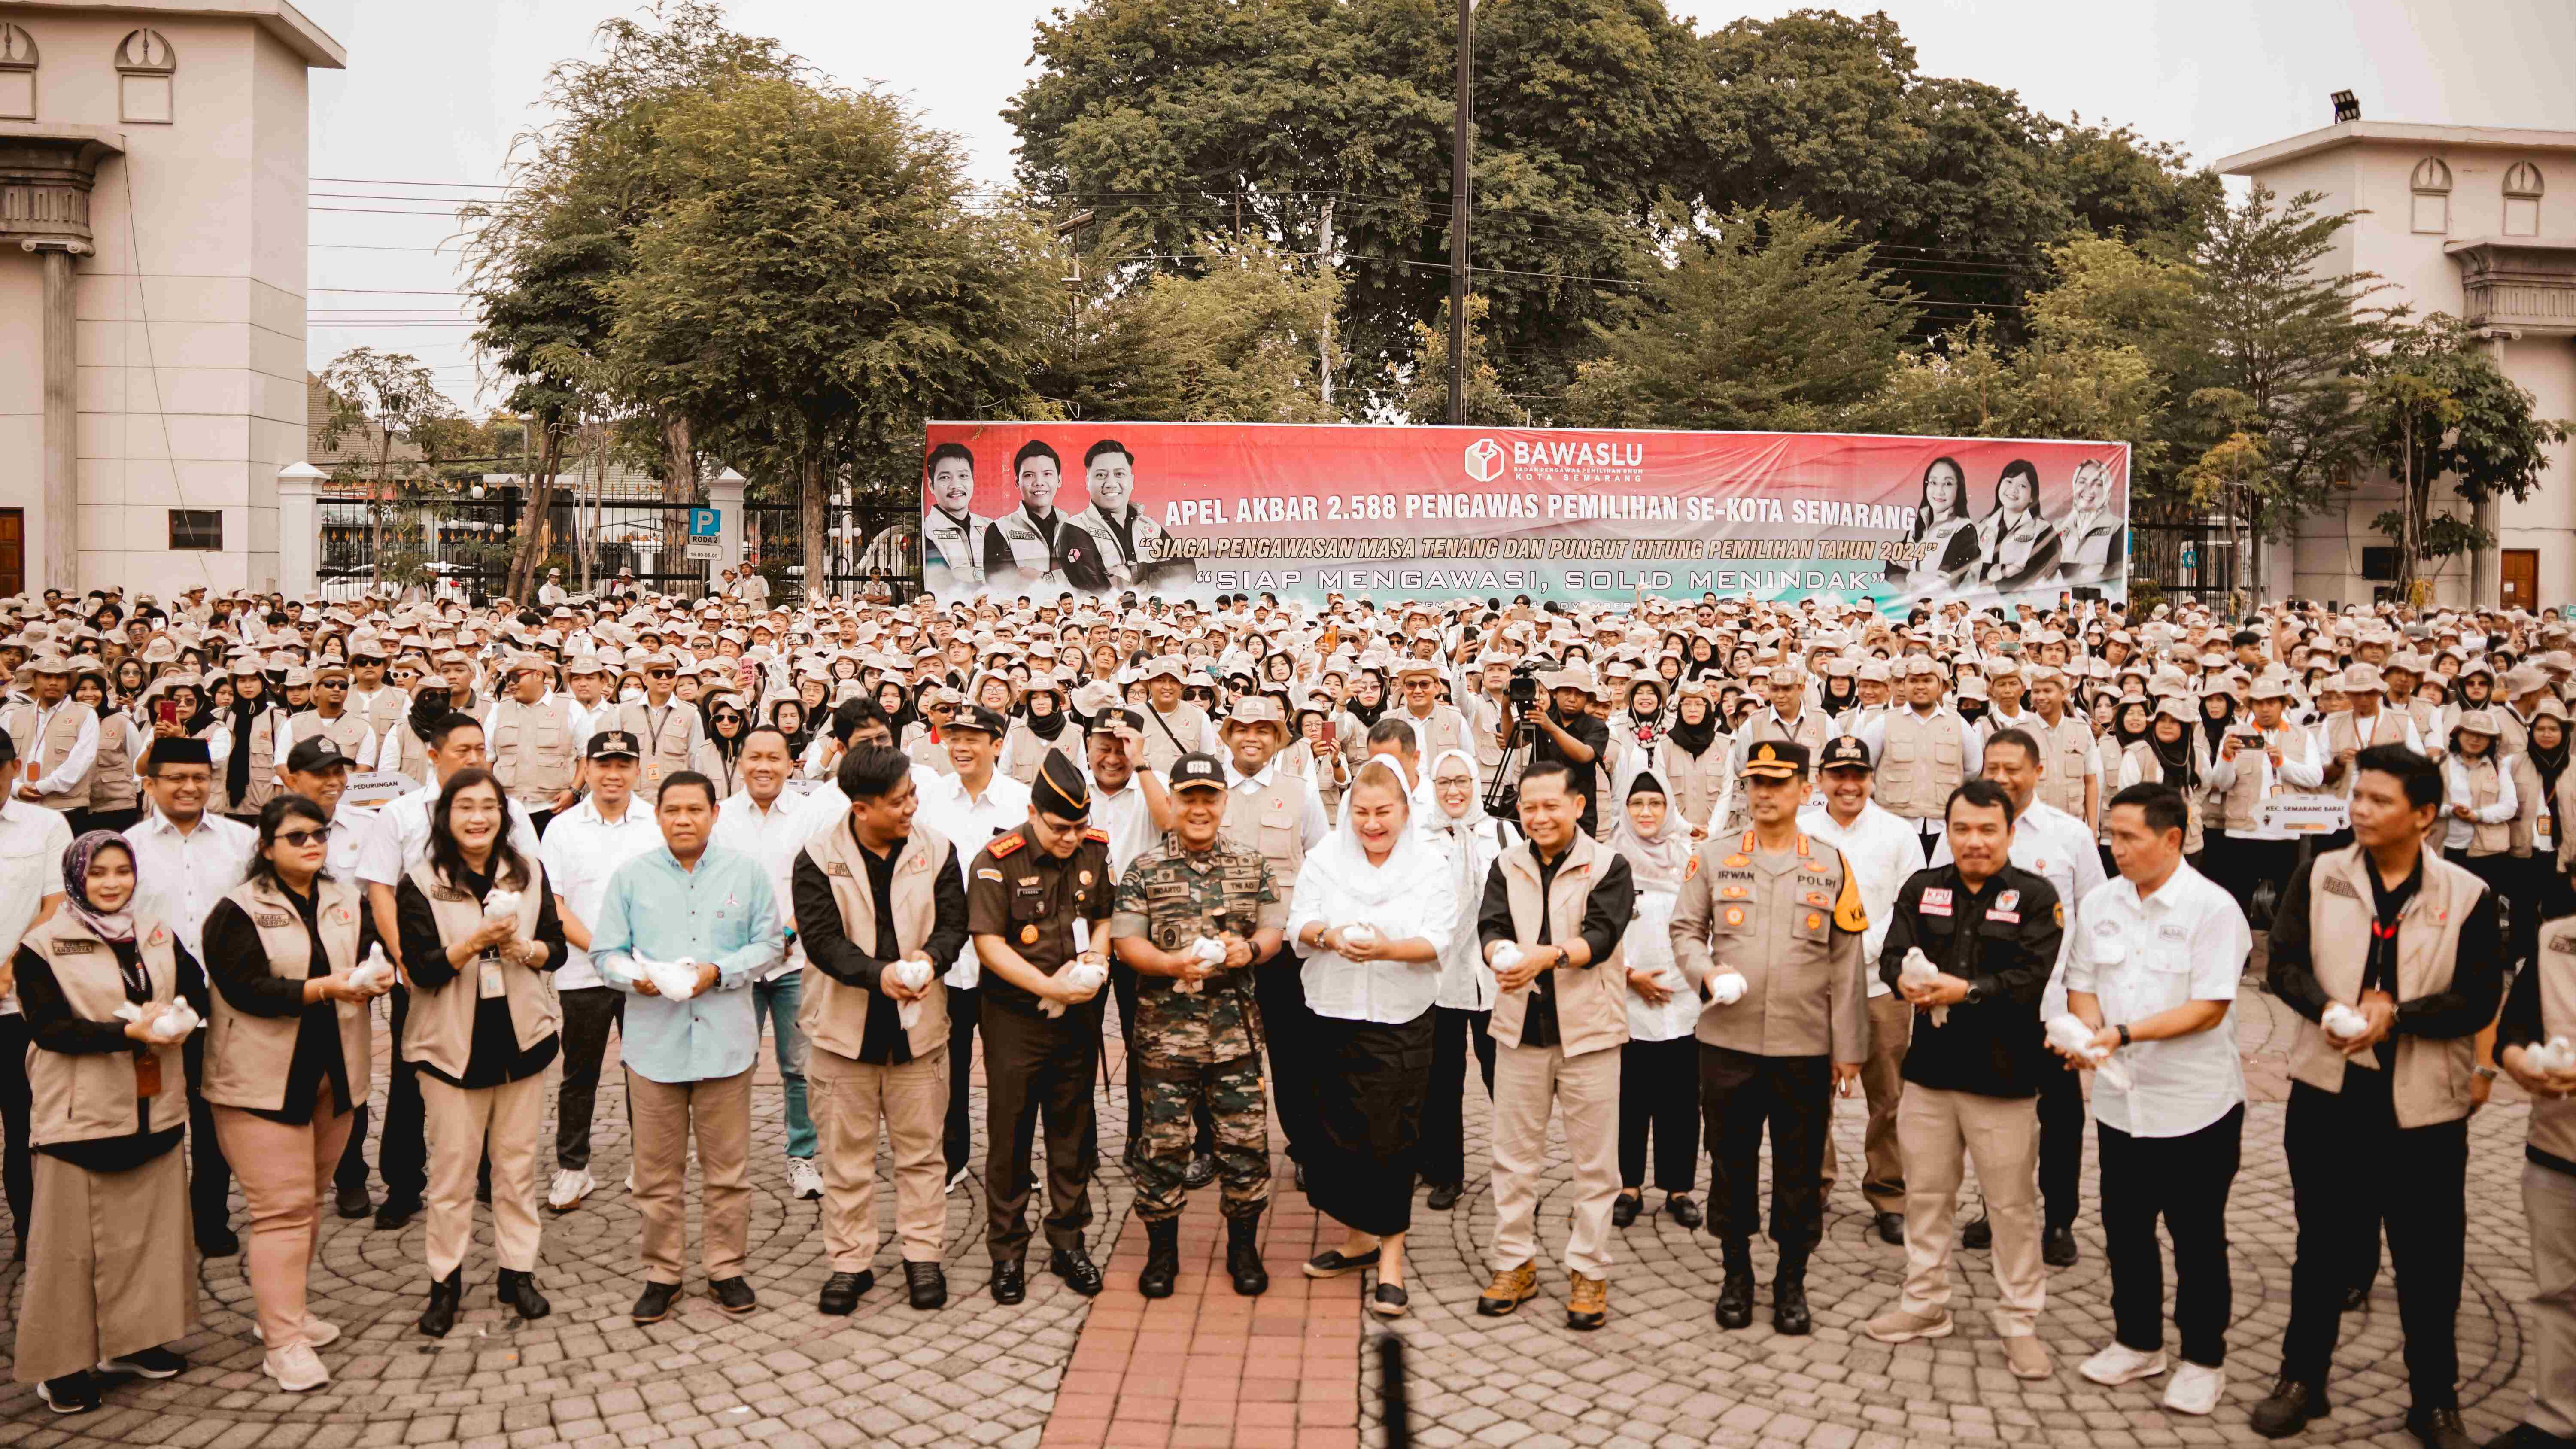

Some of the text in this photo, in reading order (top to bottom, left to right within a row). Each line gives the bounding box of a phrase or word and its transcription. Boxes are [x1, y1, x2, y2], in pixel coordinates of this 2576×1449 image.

[1514, 441, 1642, 466] BAWASLU
[1564, 474, 1641, 482] SEMARANG
[1165, 493, 1916, 531] APEL AKBAR 2.588 PENGAWAS PEMILIHAN SE-KOTA SEMARANG
[1140, 538, 1937, 561] “SIAGA PENGAWASAN MASA TENANG DAN PUNGUT HITUNG PEMILIHAN TAHUN 2024”
[1196, 570, 1885, 594] “SIAP MENGAWASI, SOLID MENINDAK”
[1186, 760, 1211, 774] 0733
[353, 781, 398, 790] PEDURUNGAN
[1718, 870, 1754, 881] IRWAN
[1798, 875, 1836, 888] POLRI
[1927, 891, 1950, 901] KPU
